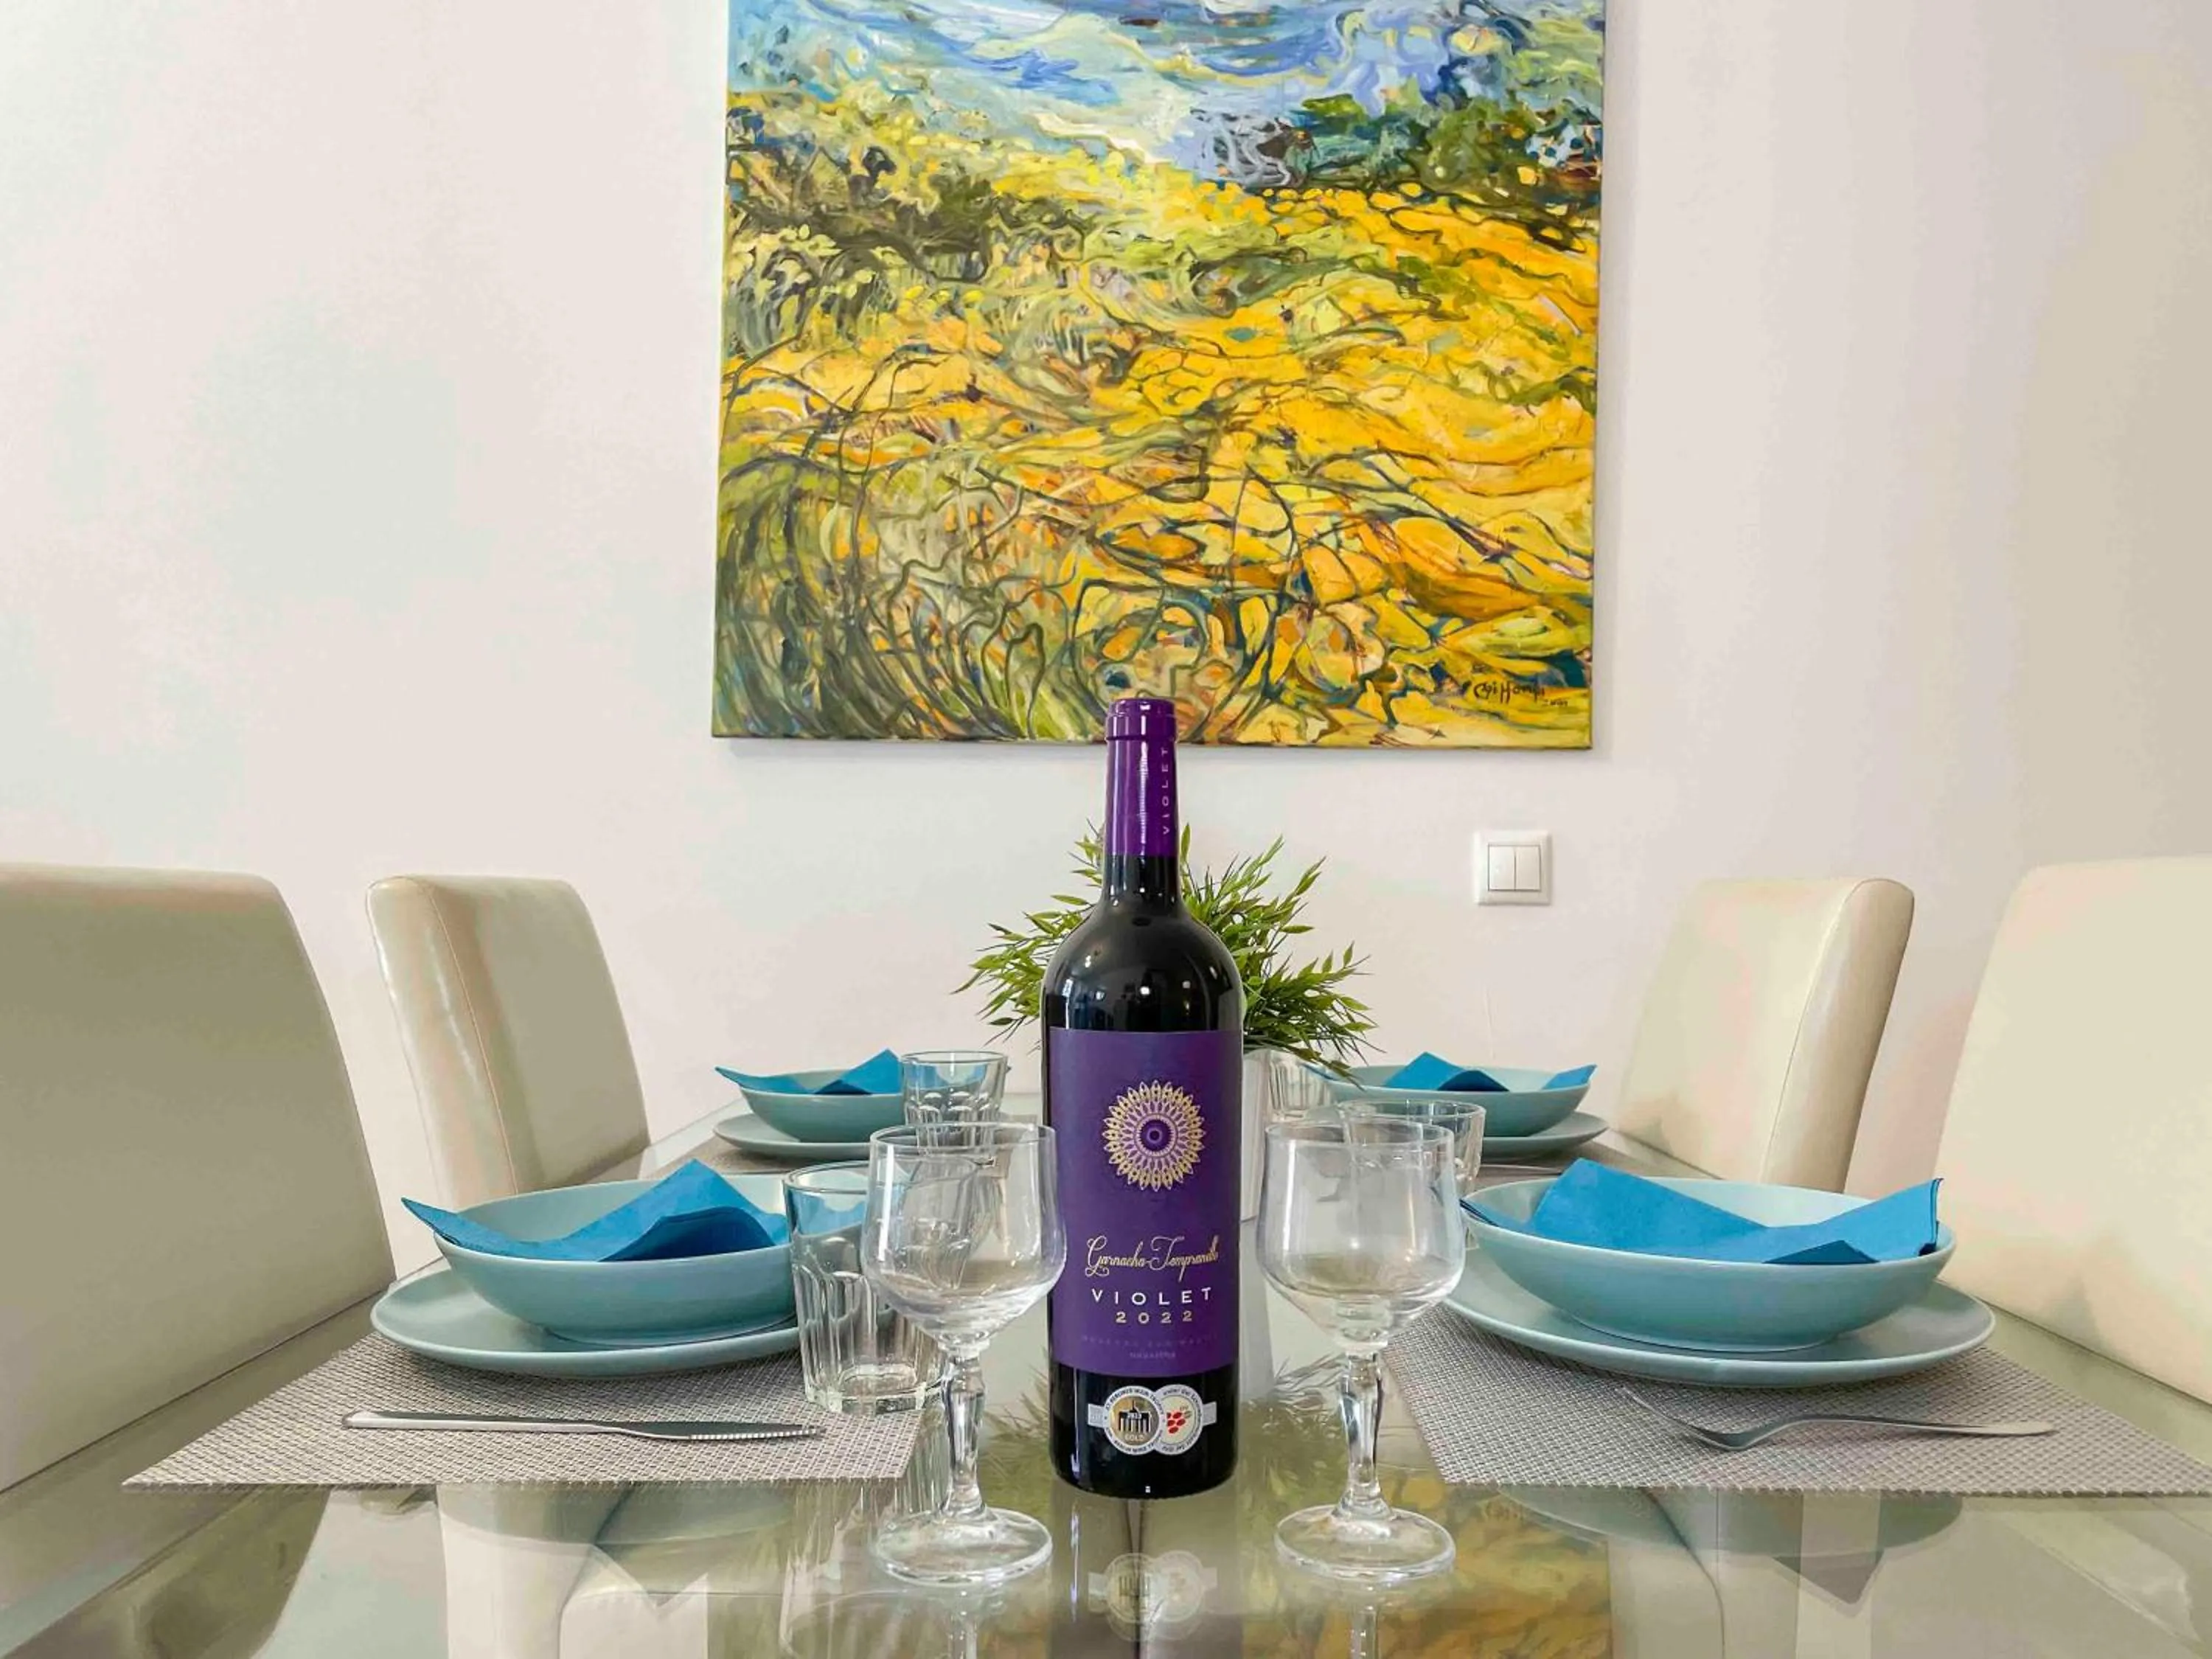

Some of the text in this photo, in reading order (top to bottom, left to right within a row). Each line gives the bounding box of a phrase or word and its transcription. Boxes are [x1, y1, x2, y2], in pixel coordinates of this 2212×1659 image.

[1161, 747, 1169, 835] VIOLET
[1091, 1287, 1211, 1305] VIOLET
[1116, 1310, 1192, 1324] 2022
